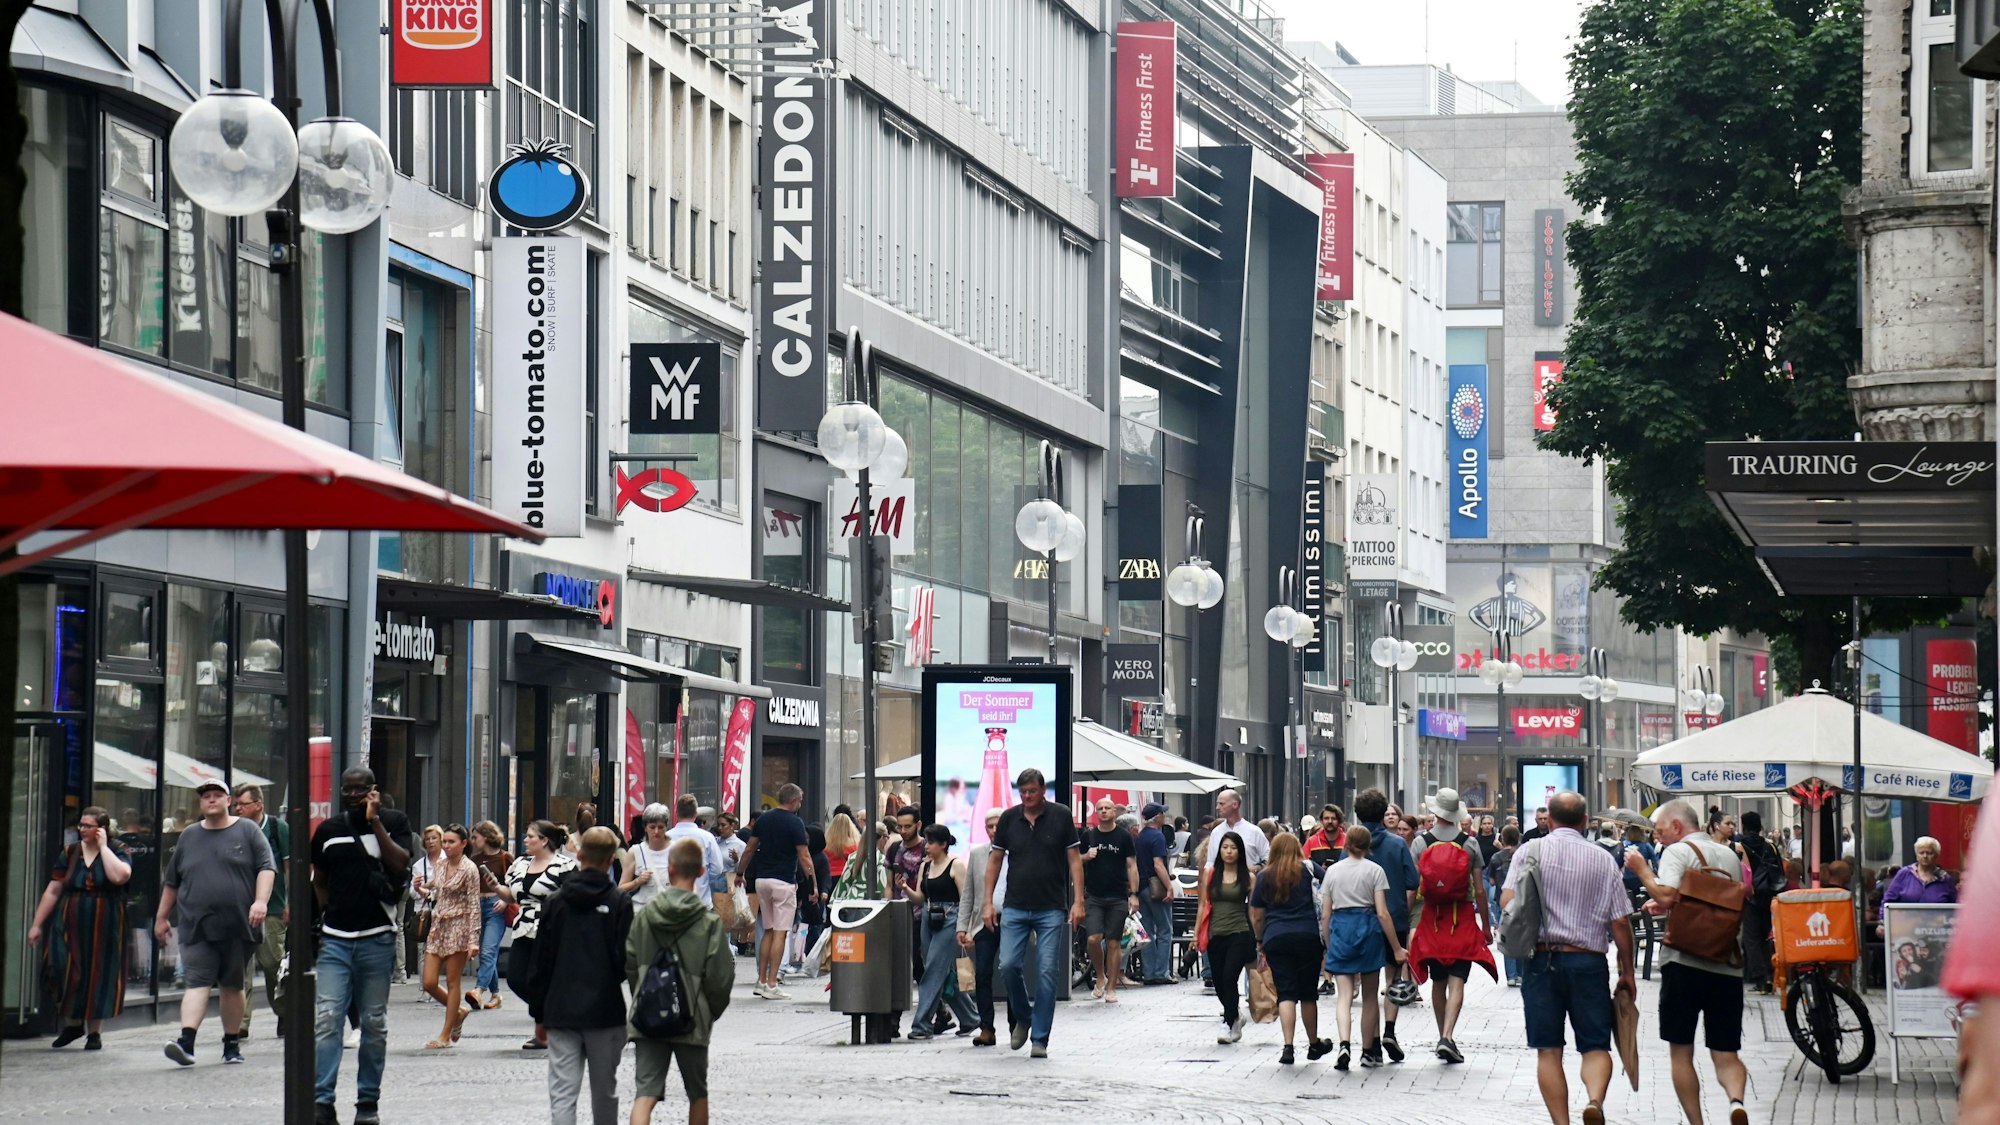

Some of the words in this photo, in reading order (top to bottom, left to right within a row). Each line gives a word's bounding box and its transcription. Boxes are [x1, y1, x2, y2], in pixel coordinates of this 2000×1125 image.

[406, 7, 478, 30] KING
[1136, 53, 1154, 88] First
[1136, 94, 1154, 151] Fitness
[772, 0, 814, 377] CALZEDONIA
[1321, 213, 1336, 262] Fitness
[547, 245, 556, 277] SKATE
[547, 285, 556, 313] SURF
[547, 321, 556, 352] SNOW
[521, 245, 545, 529] blue-tomato.com
[648, 357, 701, 420] WMF
[1727, 455, 1858, 475] TRAURING
[1867, 446, 1994, 486] Lounge
[1458, 448, 1483, 519] Apollo
[841, 495, 905, 539] HM
[1352, 541, 1395, 553] TATTOO
[1352, 555, 1395, 566] PIERCING
[1119, 558, 1161, 579] ZARA
[374, 611, 435, 662] e-tomato
[1112, 670, 1155, 680] MODA
[1115, 660, 1152, 670] VERO
[1932, 664, 1973, 679] PROBIER
[768, 697, 819, 727] CALZEDONIA
[963, 694, 982, 706] Der
[985, 694, 1029, 707] Sommer
[982, 711, 998, 721] seid
[1000, 711, 1013, 721] ihr!
[1692, 770, 1719, 782] Café
[1722, 770, 1756, 781] Riese
[1873, 773, 1902, 785] Café
[1906, 775, 1940, 789] Riese
